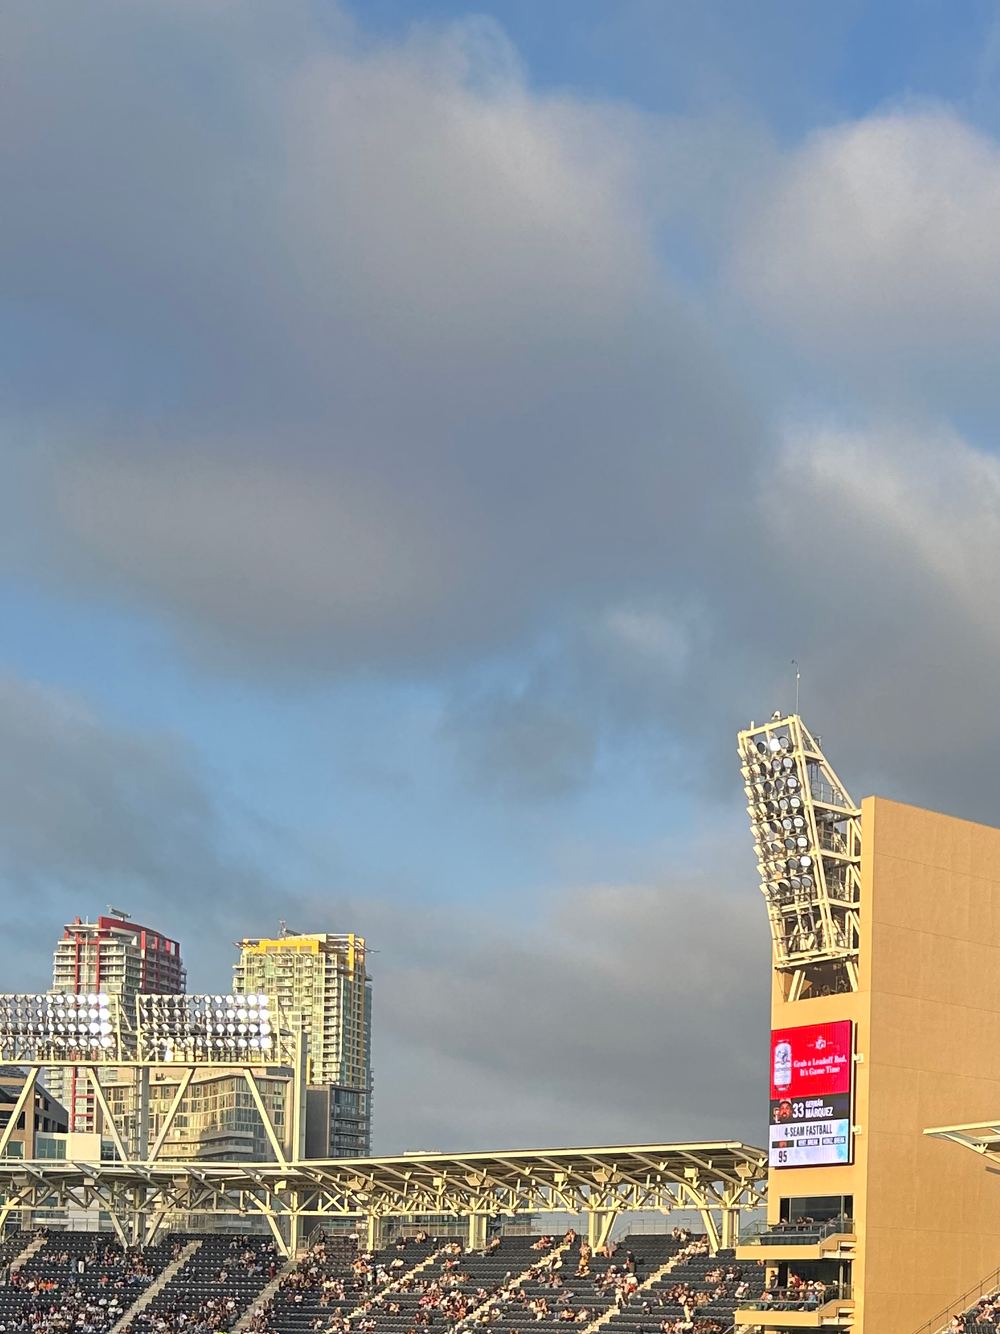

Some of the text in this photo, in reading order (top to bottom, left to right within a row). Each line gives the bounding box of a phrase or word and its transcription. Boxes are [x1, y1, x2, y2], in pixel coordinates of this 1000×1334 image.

[809, 1067, 825, 1076] Game
[792, 1102, 804, 1118] 33
[784, 1124, 832, 1137] 4-SEAM FASTBALL
[779, 1151, 787, 1162] 95
